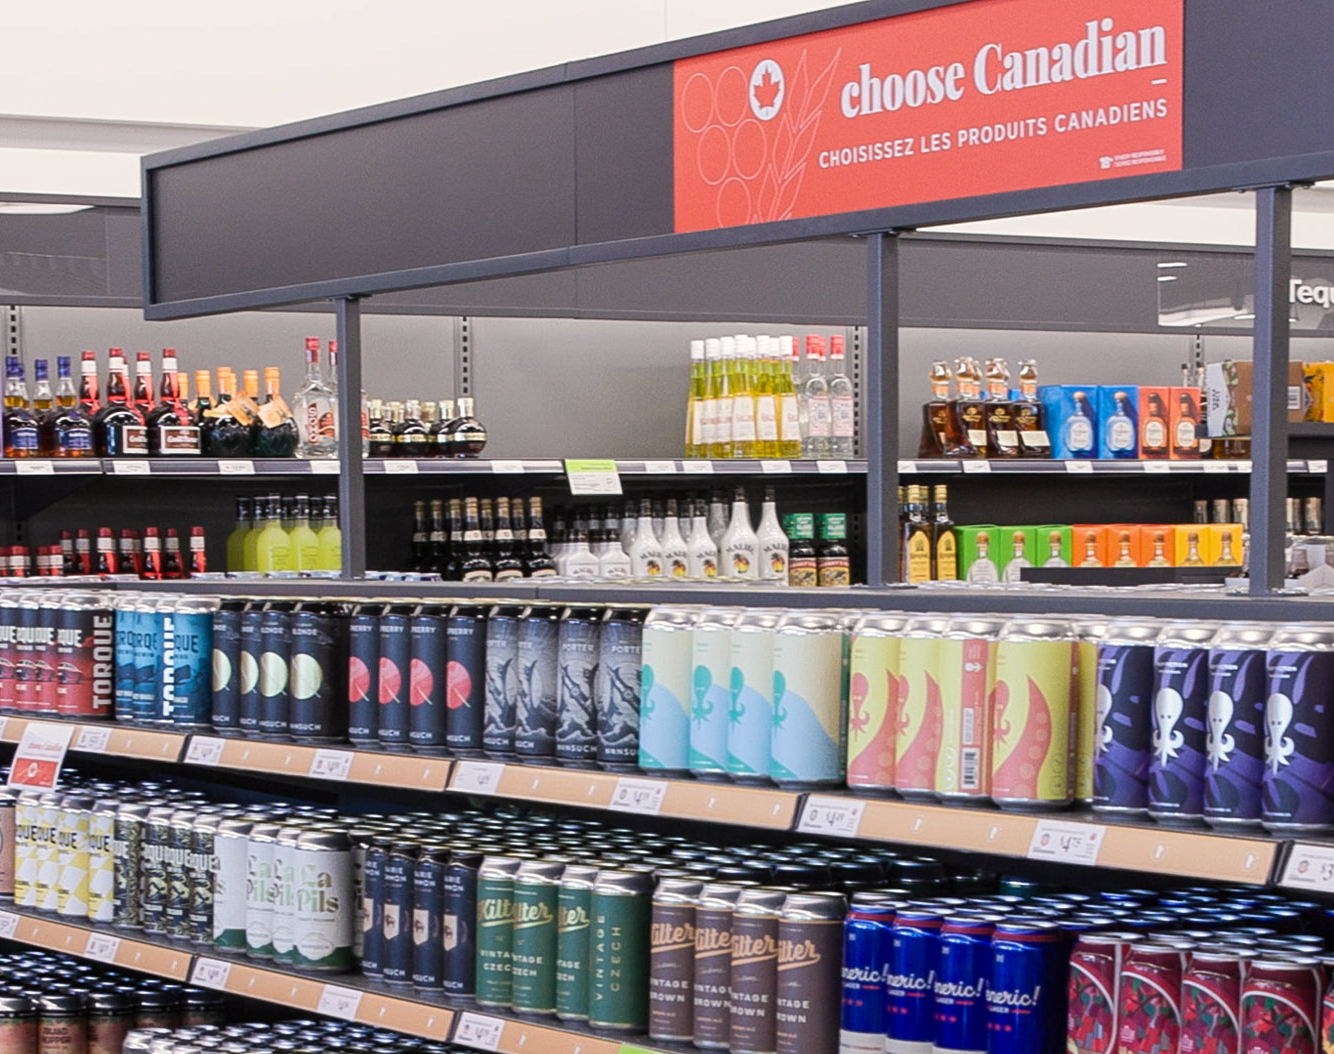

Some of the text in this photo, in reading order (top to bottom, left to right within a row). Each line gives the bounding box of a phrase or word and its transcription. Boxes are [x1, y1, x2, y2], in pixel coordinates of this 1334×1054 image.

[841, 17, 1167, 118] choose Canadian
[819, 99, 1168, 169] CHOISISSEZ LES PRODUITS CANADIENS
[93, 614, 112, 708] TORQUE
[595, 914, 605, 1002] VINTAGE
[611, 926, 621, 992] CZECH
